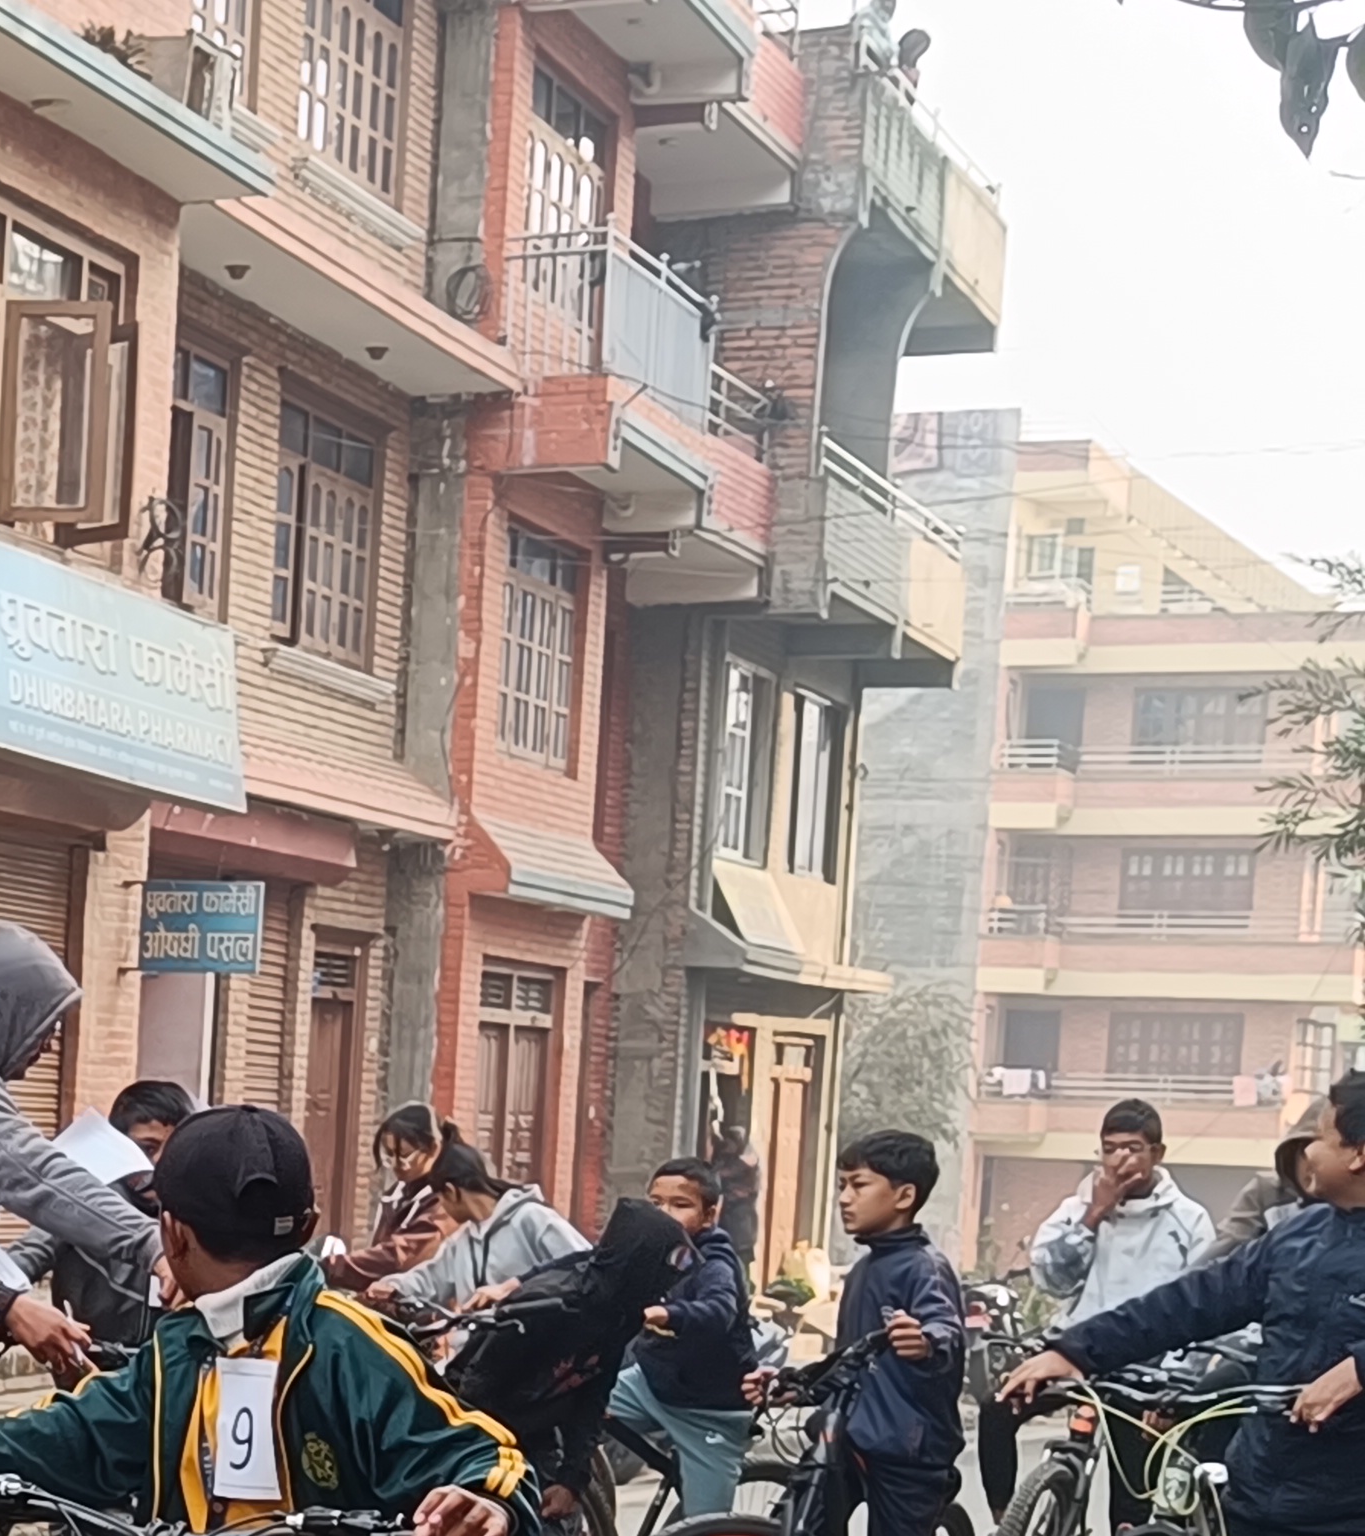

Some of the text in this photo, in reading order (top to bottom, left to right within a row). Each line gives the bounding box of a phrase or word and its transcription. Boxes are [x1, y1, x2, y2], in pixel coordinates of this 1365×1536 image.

[8, 668, 135, 740] DHURBATARA
[138, 710, 234, 767] PHARMACY
[206, 932, 254, 962] पसल
[229, 1406, 254, 1470] 9
